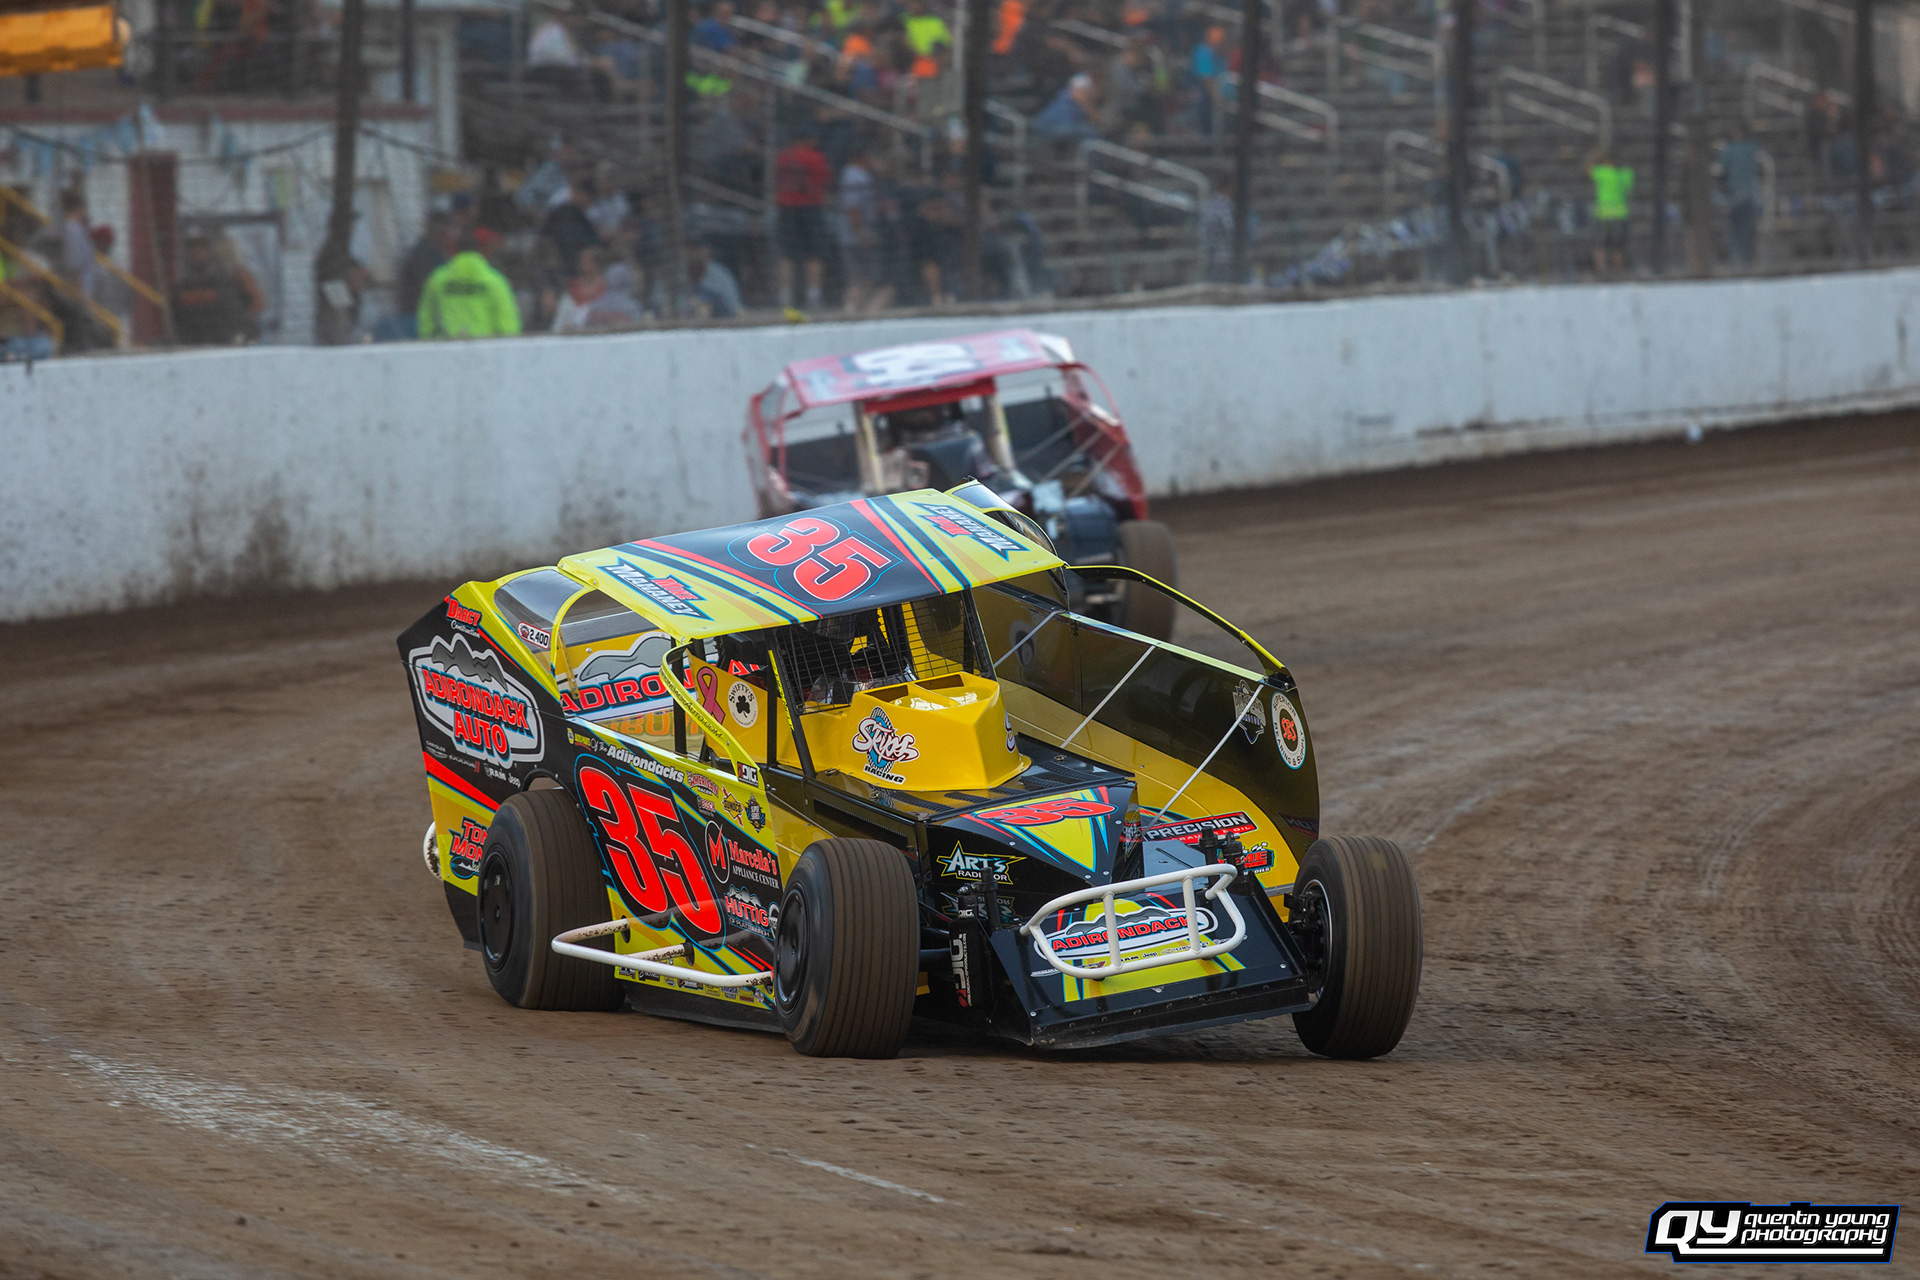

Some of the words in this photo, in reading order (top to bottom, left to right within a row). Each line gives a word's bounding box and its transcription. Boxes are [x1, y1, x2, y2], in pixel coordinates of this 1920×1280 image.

[747, 517, 891, 602] 35
[447, 598, 481, 626] DARCY
[421, 667, 530, 732] ADIRONDACK
[728, 682, 755, 704] SWIFTY'S
[454, 709, 508, 755] AUTO
[607, 744, 685, 783] Adirondacks
[864, 765, 904, 783] RACING
[689, 771, 720, 798] AMERICAN
[977, 798, 1116, 825] 35
[1146, 816, 1249, 840] PRECISION
[579, 766, 721, 935] 35
[727, 839, 778, 876] Marcella's
[732, 865, 760, 882] APPLIANCE
[759, 874, 780, 889] CENTER
[957, 870, 1007, 881] RADIOR
[724, 895, 769, 927] HUTTIG
